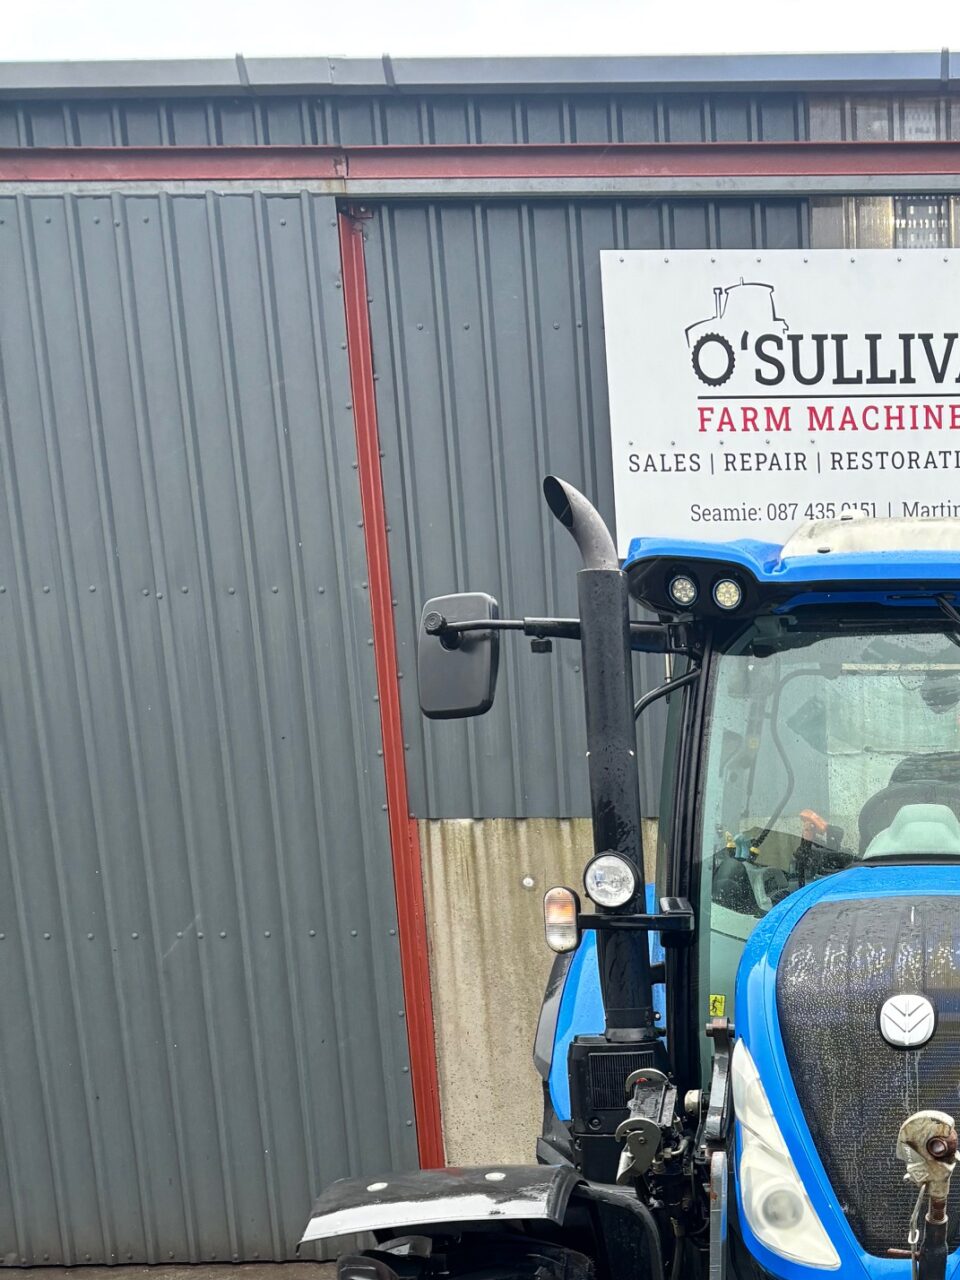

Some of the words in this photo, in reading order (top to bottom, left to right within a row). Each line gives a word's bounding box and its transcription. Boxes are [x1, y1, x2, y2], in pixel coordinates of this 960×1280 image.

[697, 406, 792, 432] FARM
[628, 453, 701, 473] SALES
[723, 452, 808, 472] REPAIR
[690, 502, 762, 522] Seamie:
[767, 503, 799, 521] 087
[804, 502, 835, 520] 435
